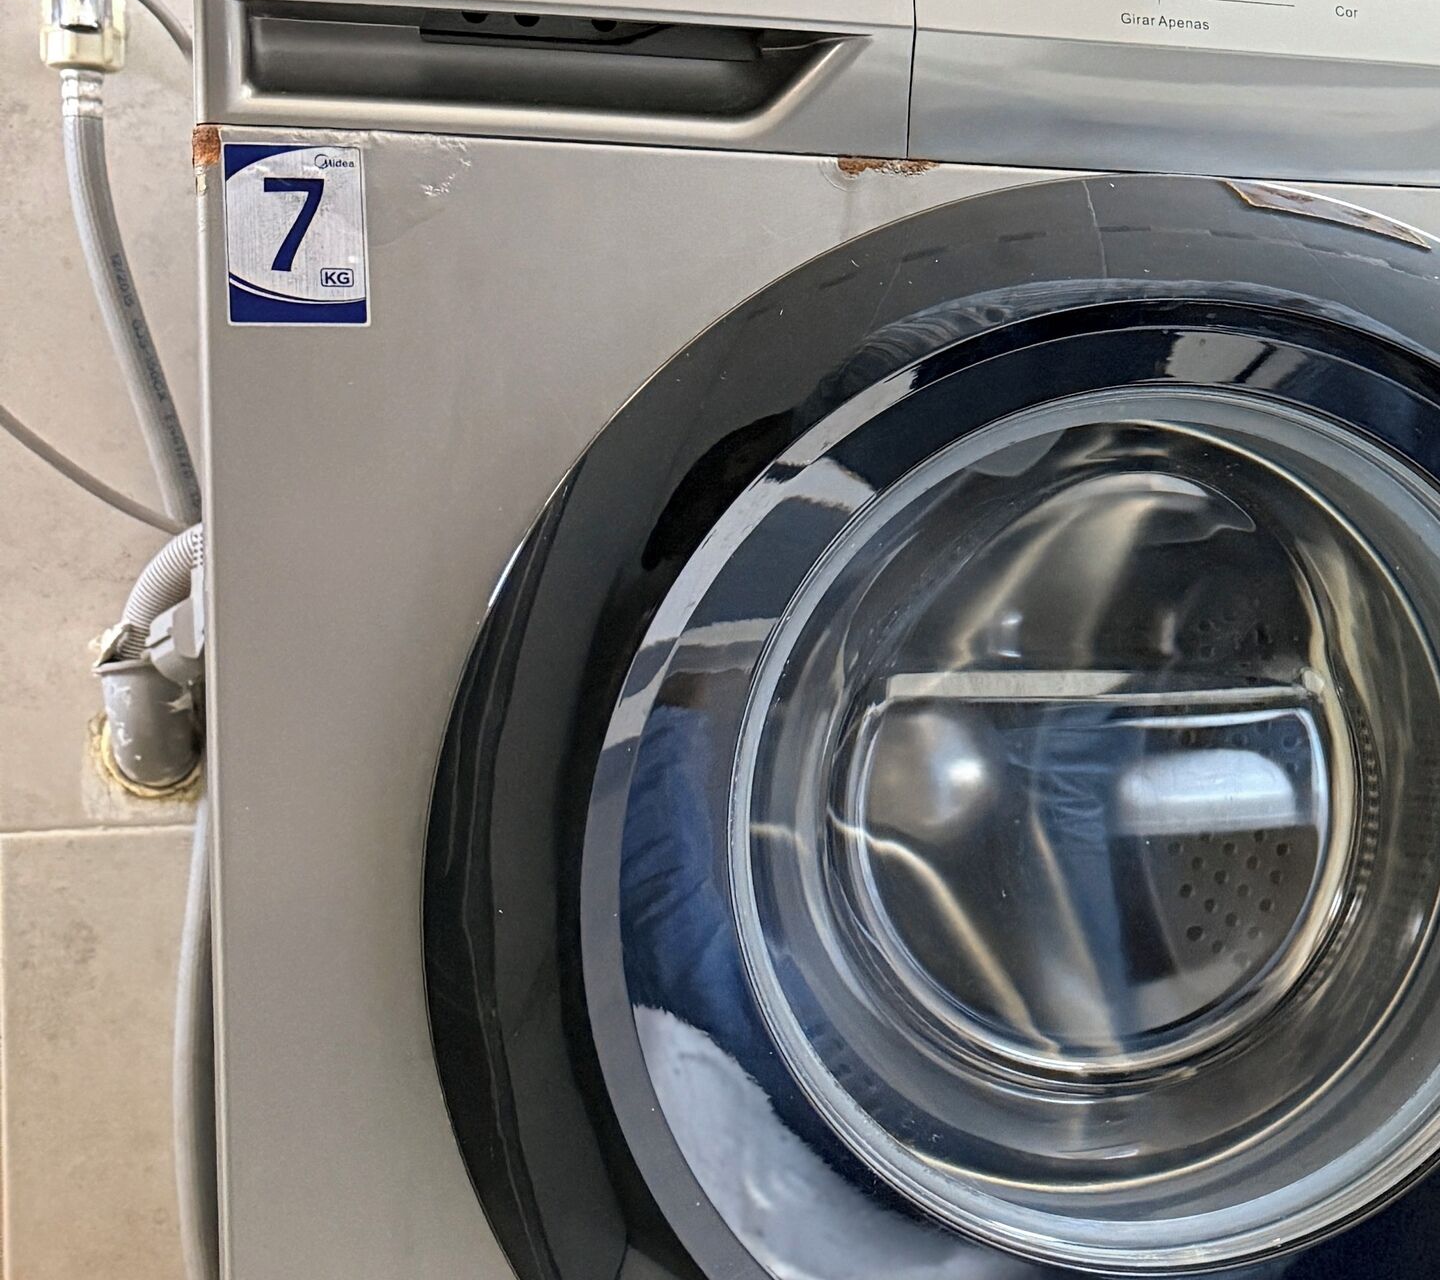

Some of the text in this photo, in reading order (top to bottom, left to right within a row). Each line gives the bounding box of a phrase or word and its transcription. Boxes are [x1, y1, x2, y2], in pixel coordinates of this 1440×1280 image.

[1335, 5, 1358, 18] Cor
[1121, 12, 1210, 30] Girar Apenas
[314, 153, 355, 170] Midea
[263, 177, 325, 272] 7
[324, 271, 350, 285] KG
